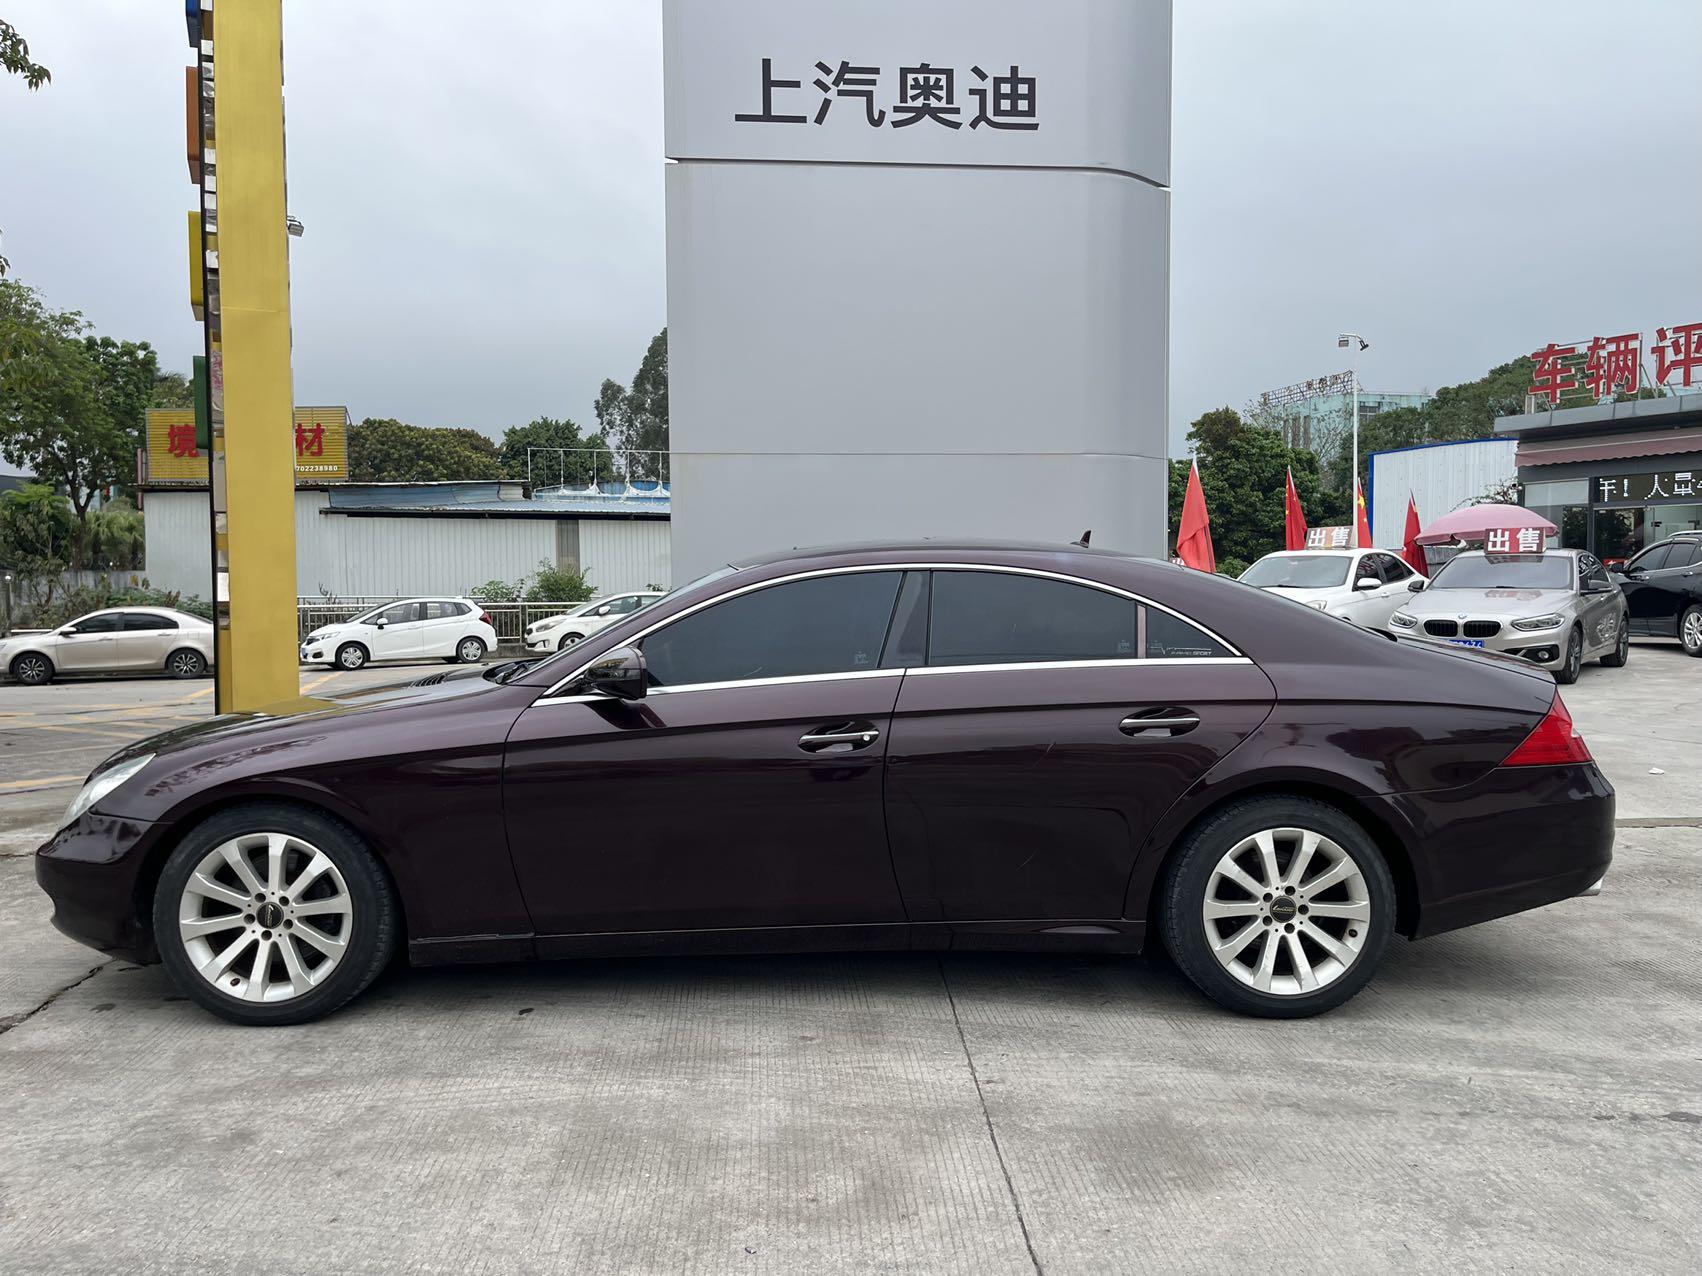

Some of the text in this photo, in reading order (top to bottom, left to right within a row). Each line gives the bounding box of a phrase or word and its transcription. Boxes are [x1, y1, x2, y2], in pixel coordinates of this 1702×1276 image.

[735, 58, 1039, 131] 上汽奥迪
[1528, 323, 1702, 404] 车辆评
[1308, 526, 1350, 547] 出售
[1487, 527, 1540, 552] 出售
